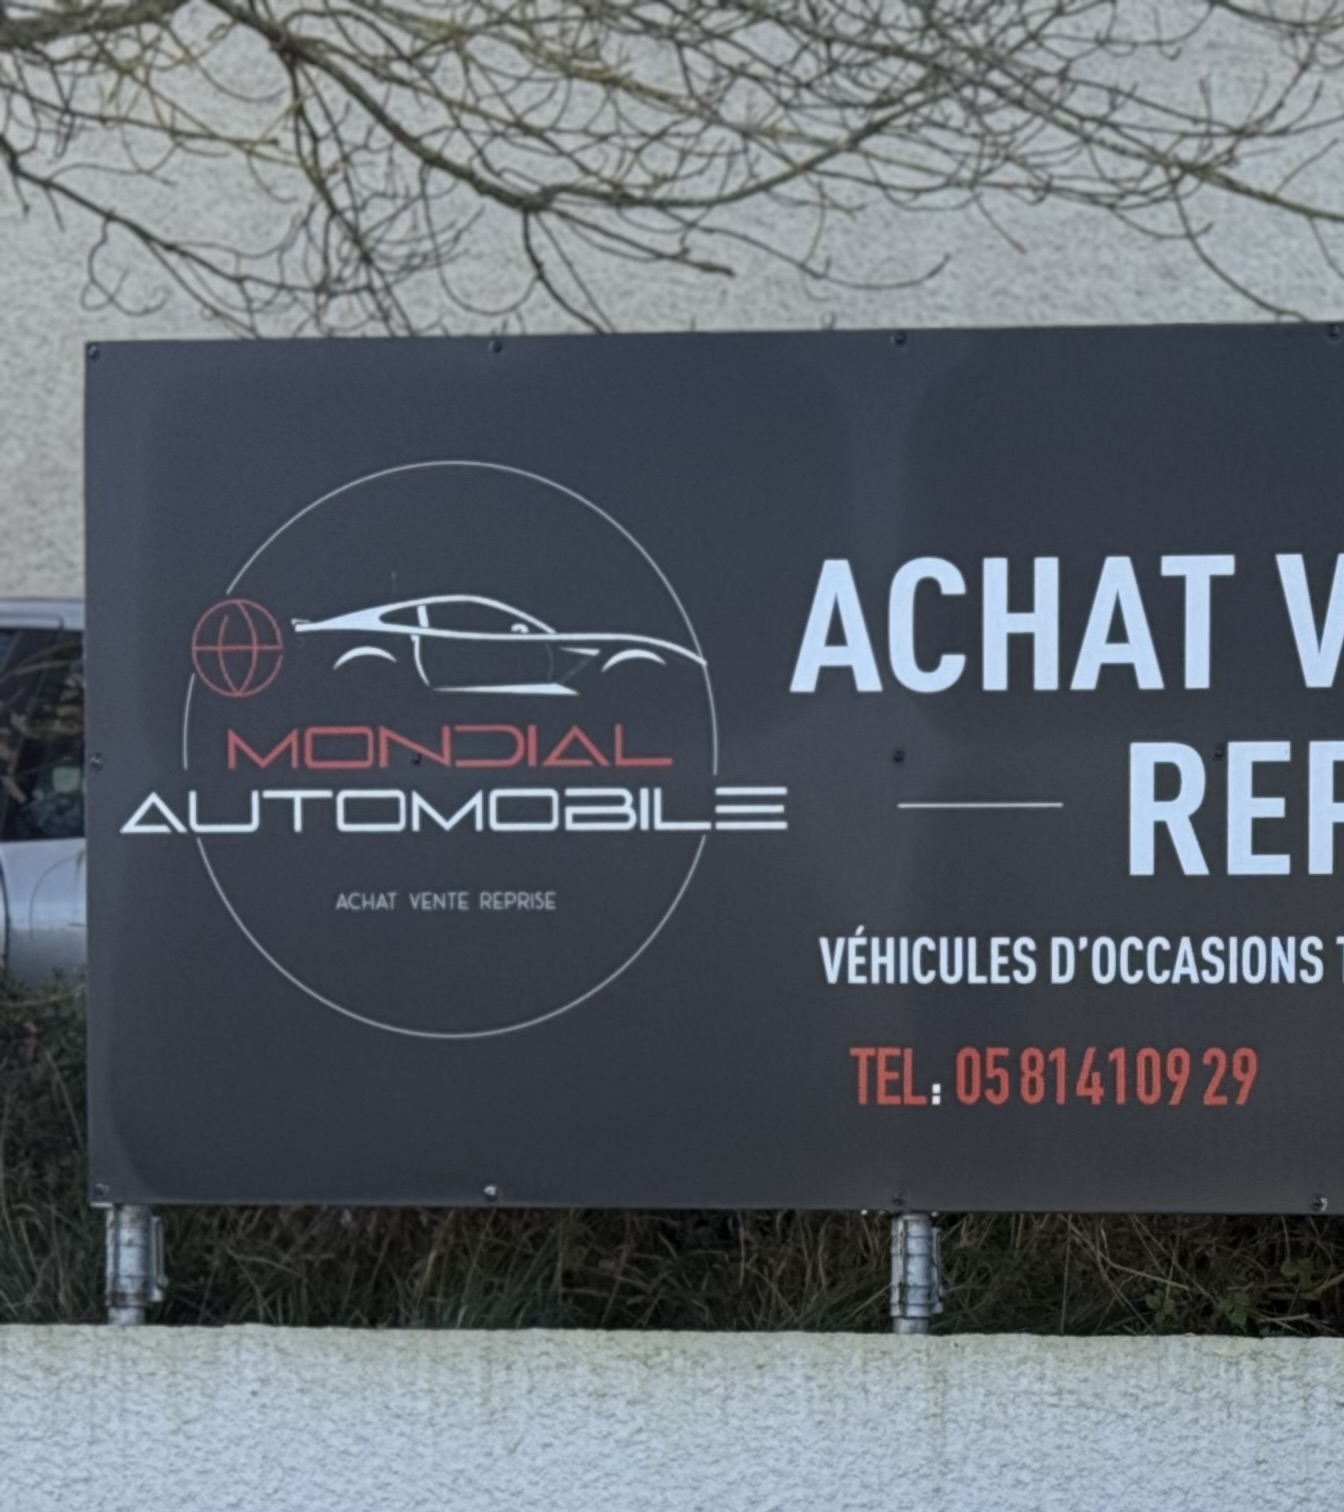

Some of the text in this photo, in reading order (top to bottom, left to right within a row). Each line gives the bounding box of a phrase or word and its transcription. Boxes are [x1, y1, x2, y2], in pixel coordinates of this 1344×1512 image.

[789, 555, 1235, 693] ACHAT
[228, 724, 673, 769] MONDIAL
[120, 786, 788, 834] AUTOMOBILE
[335, 892, 557, 911] ACHAT VENTE REPRISE
[819, 925, 1037, 985] VÉHICULES
